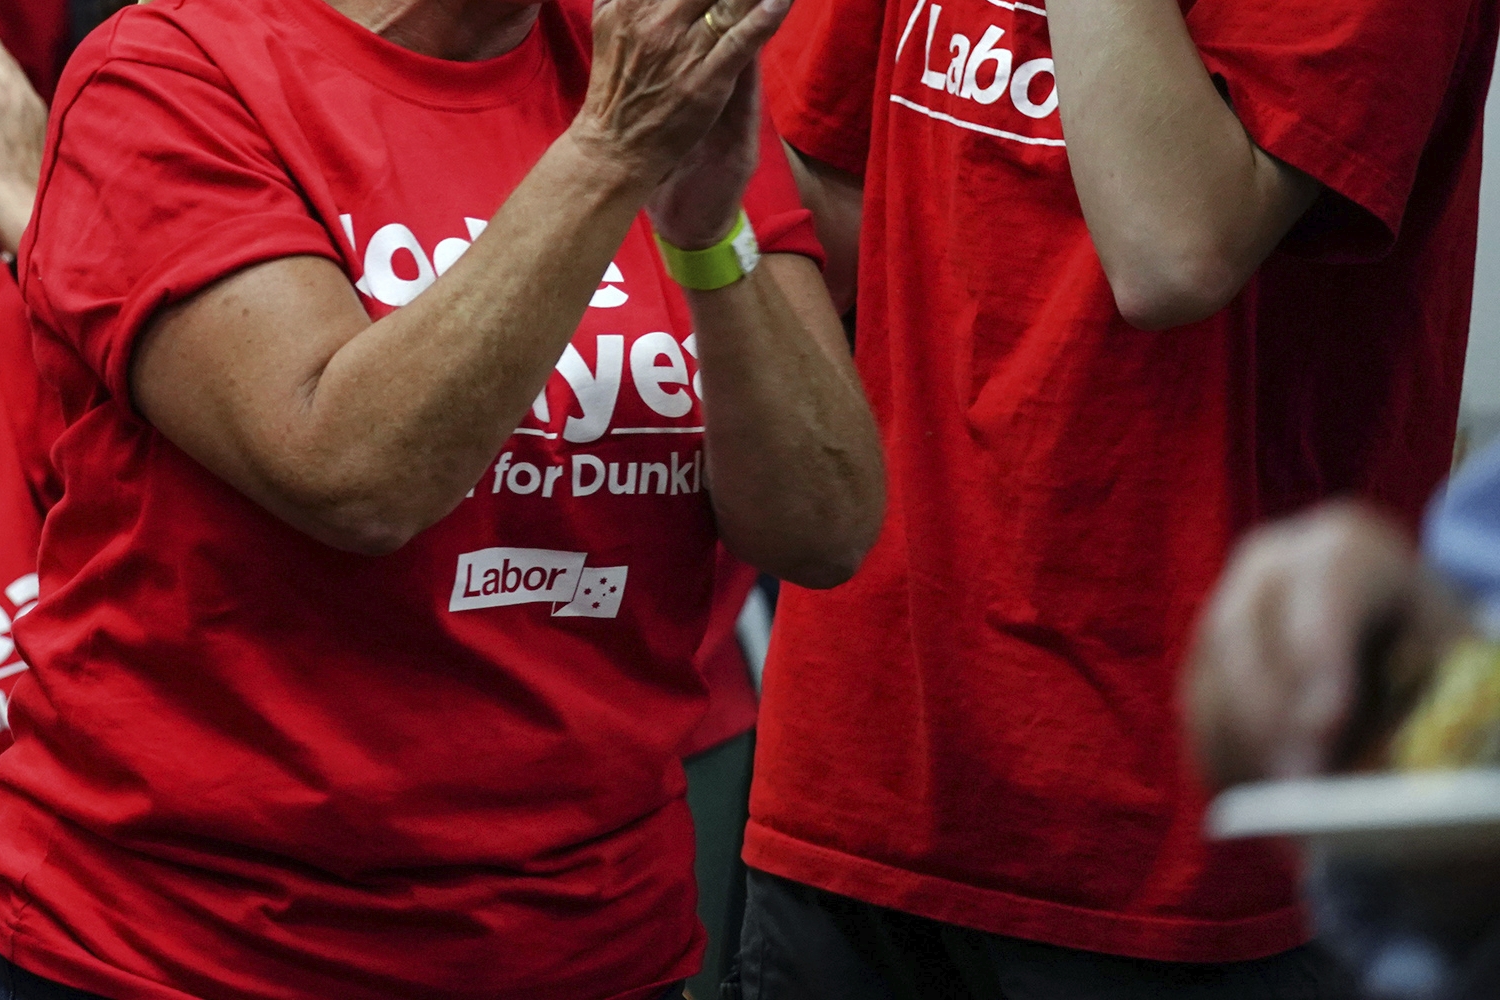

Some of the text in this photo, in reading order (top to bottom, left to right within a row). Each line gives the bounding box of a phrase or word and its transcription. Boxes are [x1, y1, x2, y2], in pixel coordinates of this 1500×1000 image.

[921, 3, 1059, 118] Labo
[492, 452, 563, 498] for
[463, 558, 567, 598] Labor
